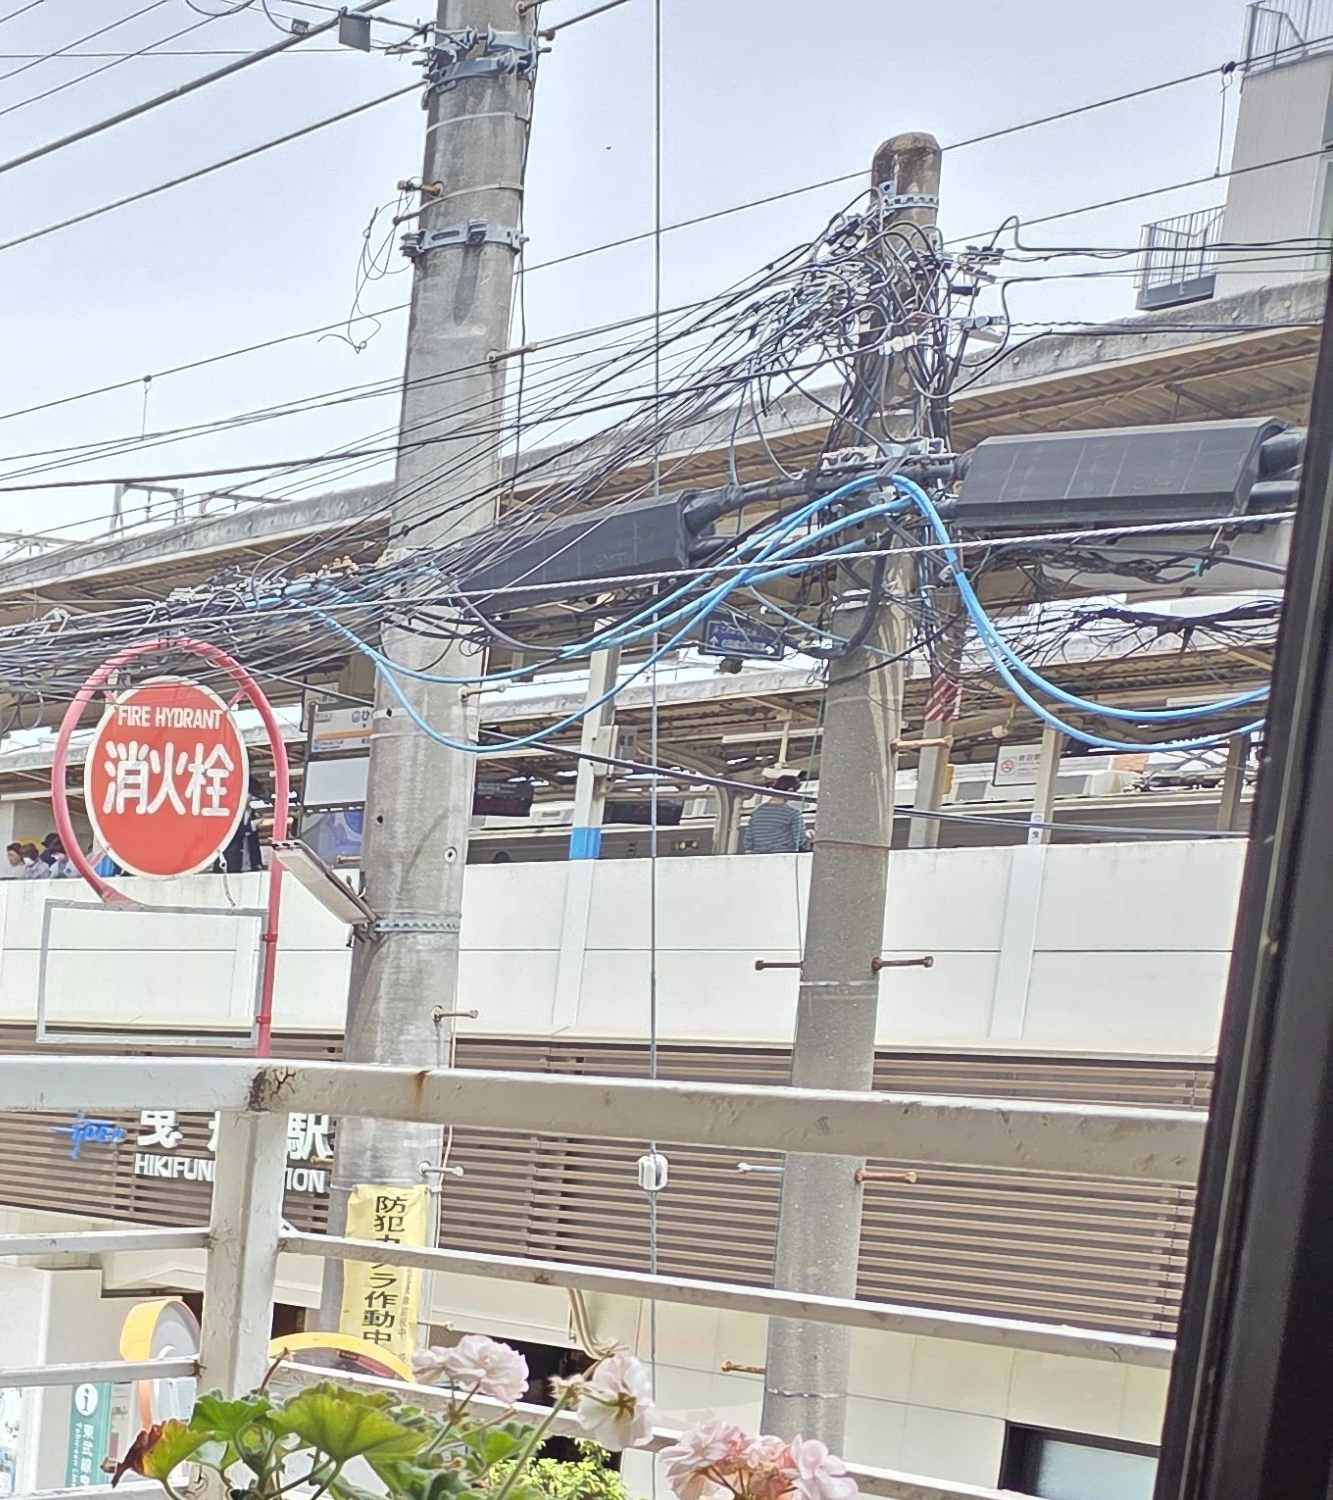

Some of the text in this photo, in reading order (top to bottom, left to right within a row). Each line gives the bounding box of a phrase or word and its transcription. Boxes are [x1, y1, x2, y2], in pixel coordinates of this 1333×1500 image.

[118, 705, 223, 730] FIRE HYDRANT
[102, 740, 235, 817] 消火栓
[136, 1110, 334, 1160] 曳駅
[134, 1153, 216, 1182] HIKIFUN
[360, 1195, 408, 1346] 防犯カラ作動中
